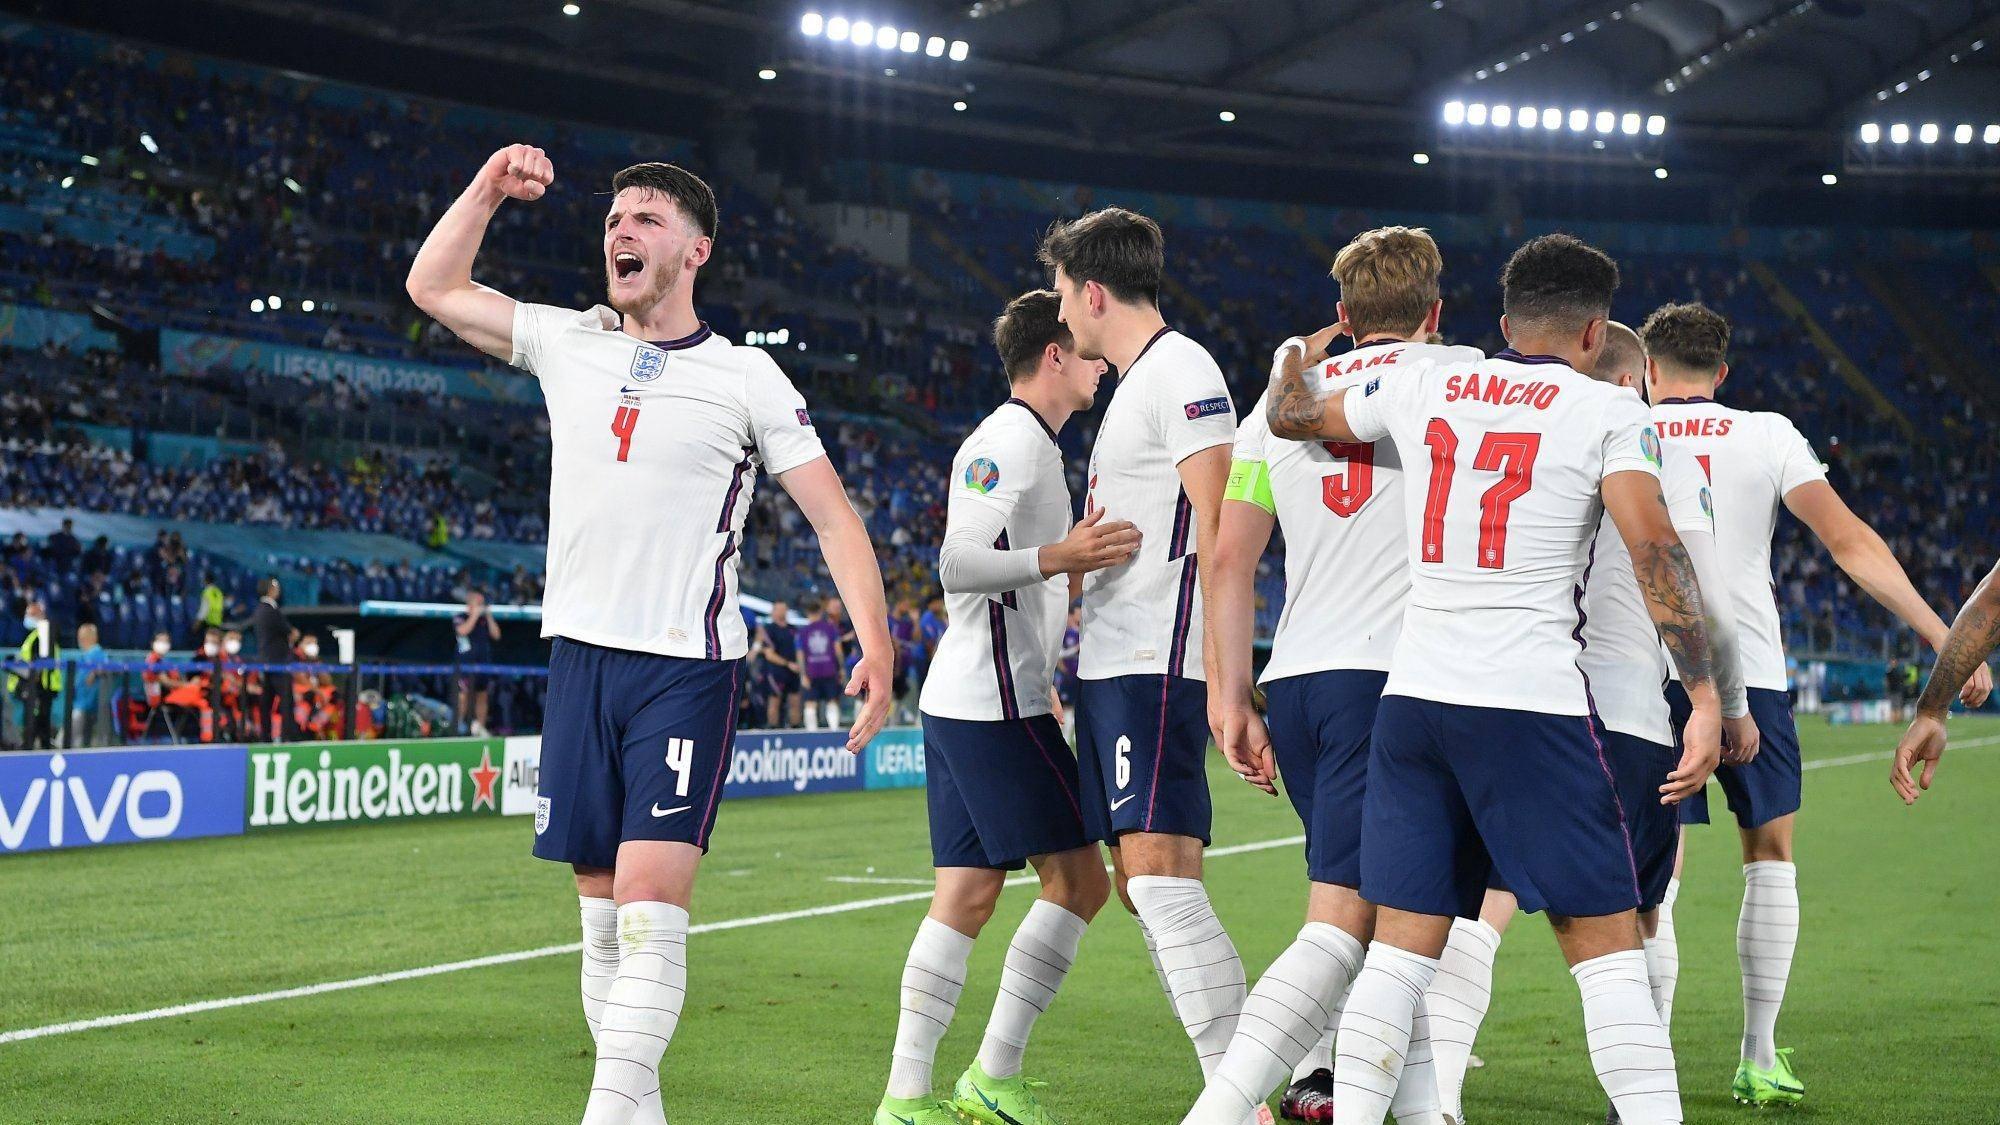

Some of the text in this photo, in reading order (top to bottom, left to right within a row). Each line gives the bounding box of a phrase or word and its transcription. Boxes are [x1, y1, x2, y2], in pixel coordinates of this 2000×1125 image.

[394, 368, 447, 394] 2020
[1326, 349, 1405, 379] KANE
[1200, 401, 1229, 413] RESPECT
[1445, 374, 1560, 411] SANCHO
[611, 406, 640, 462] 4
[1654, 418, 1733, 439] TONES
[1422, 417, 1542, 569] 17
[509, 759, 539, 794] Alip
[665, 737, 694, 797] 4
[724, 738, 856, 791] ooking.com
[876, 743, 912, 774] UEFA
[1115, 735, 1131, 790] 6
[0, 753, 183, 849] vivo
[250, 749, 463, 826] Heineken
